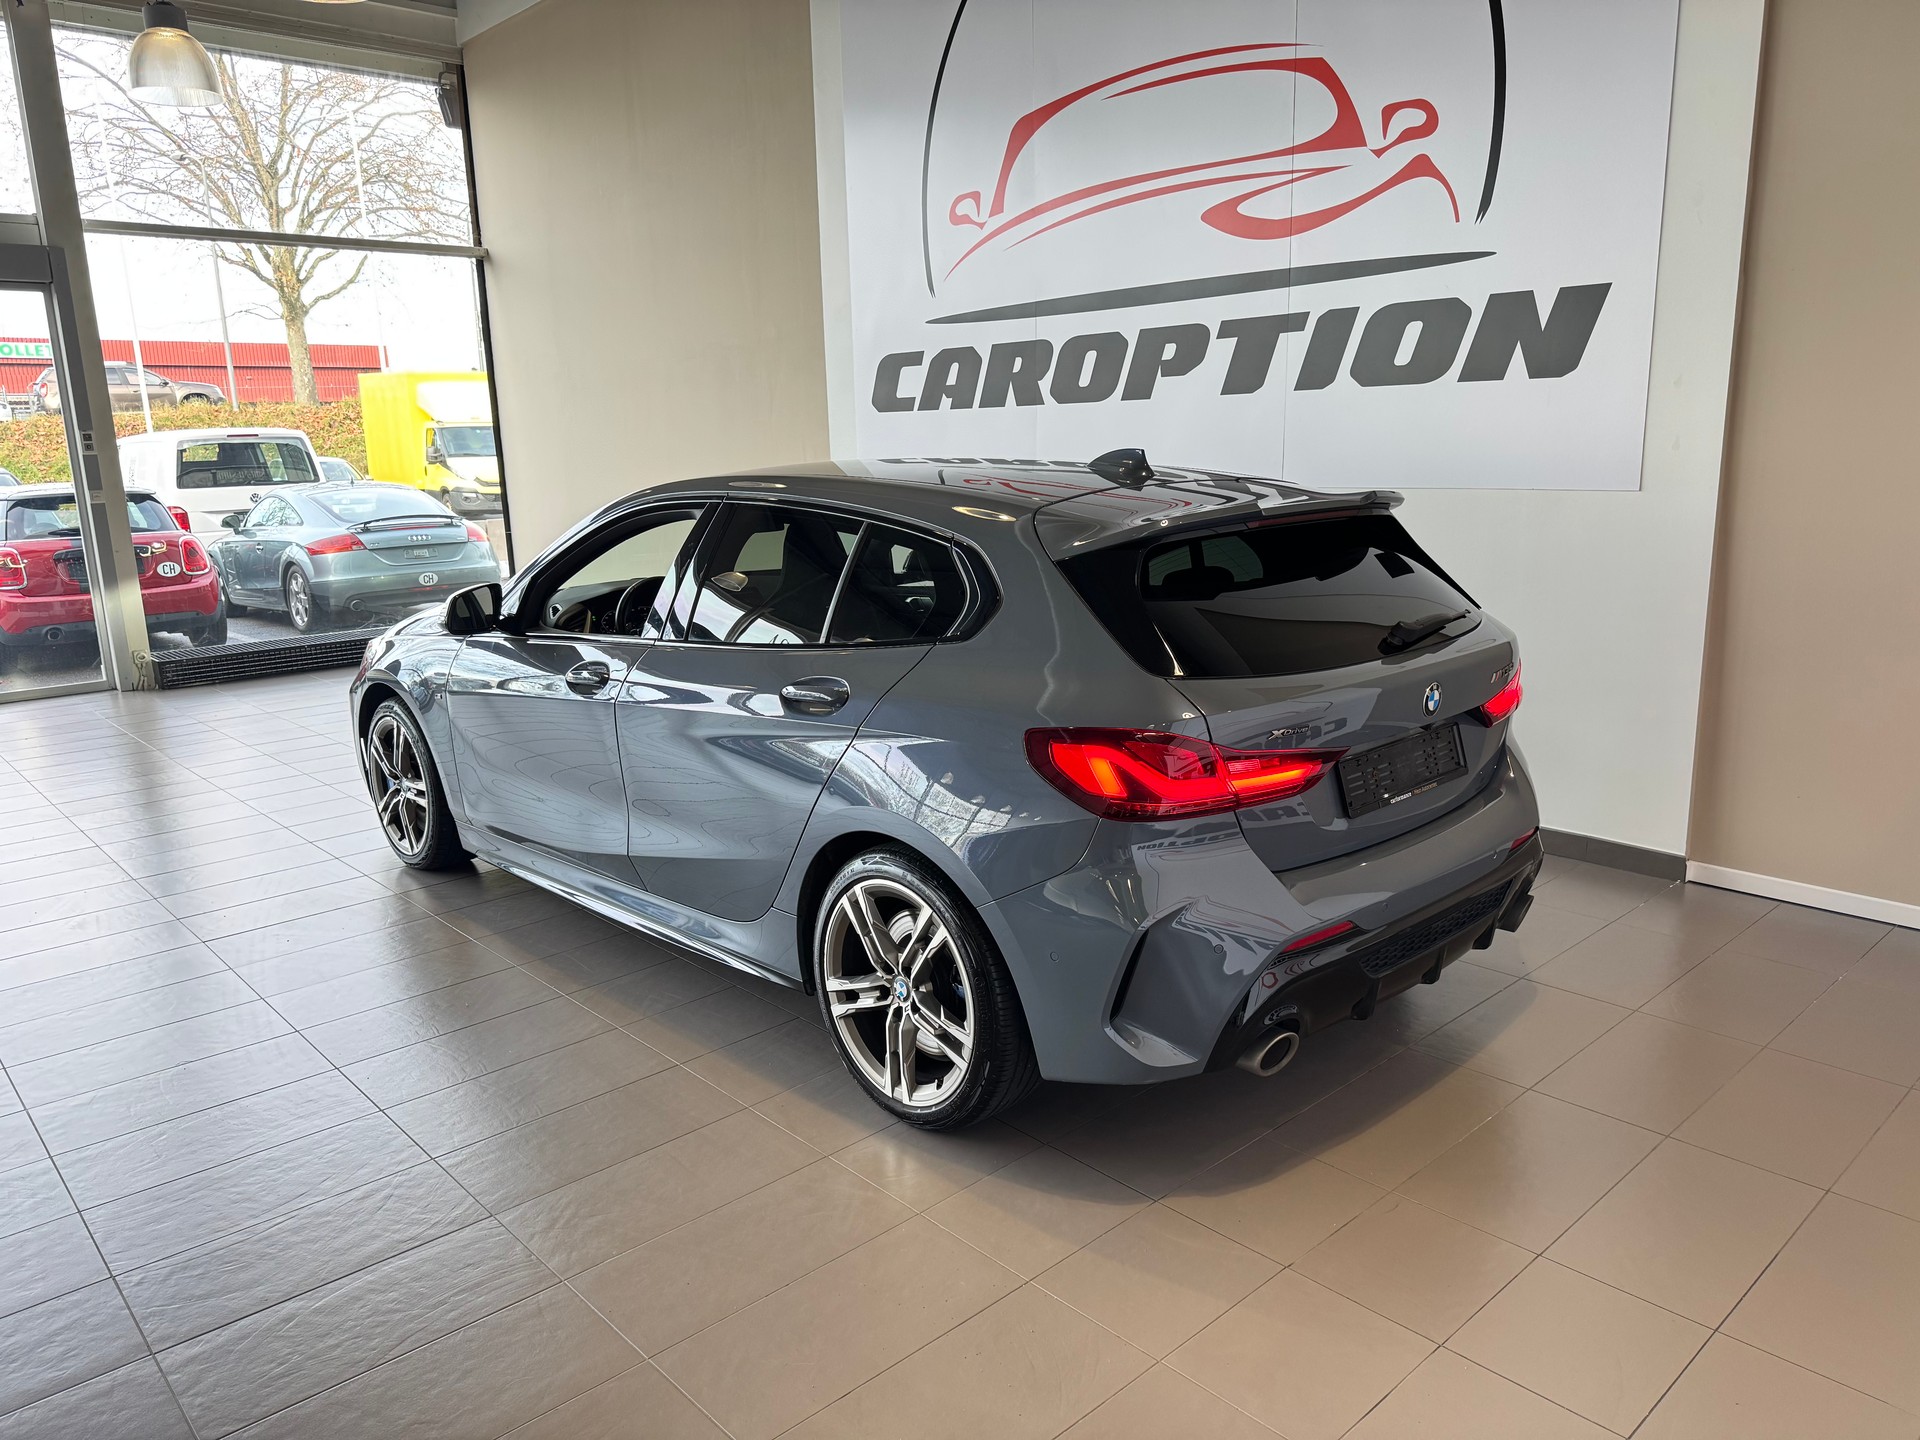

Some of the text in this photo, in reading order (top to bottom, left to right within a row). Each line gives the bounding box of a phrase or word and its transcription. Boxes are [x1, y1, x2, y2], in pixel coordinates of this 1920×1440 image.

[871, 283, 1612, 413] CAROPTION
[162, 564, 176, 574] CH
[423, 574, 434, 584] CH
